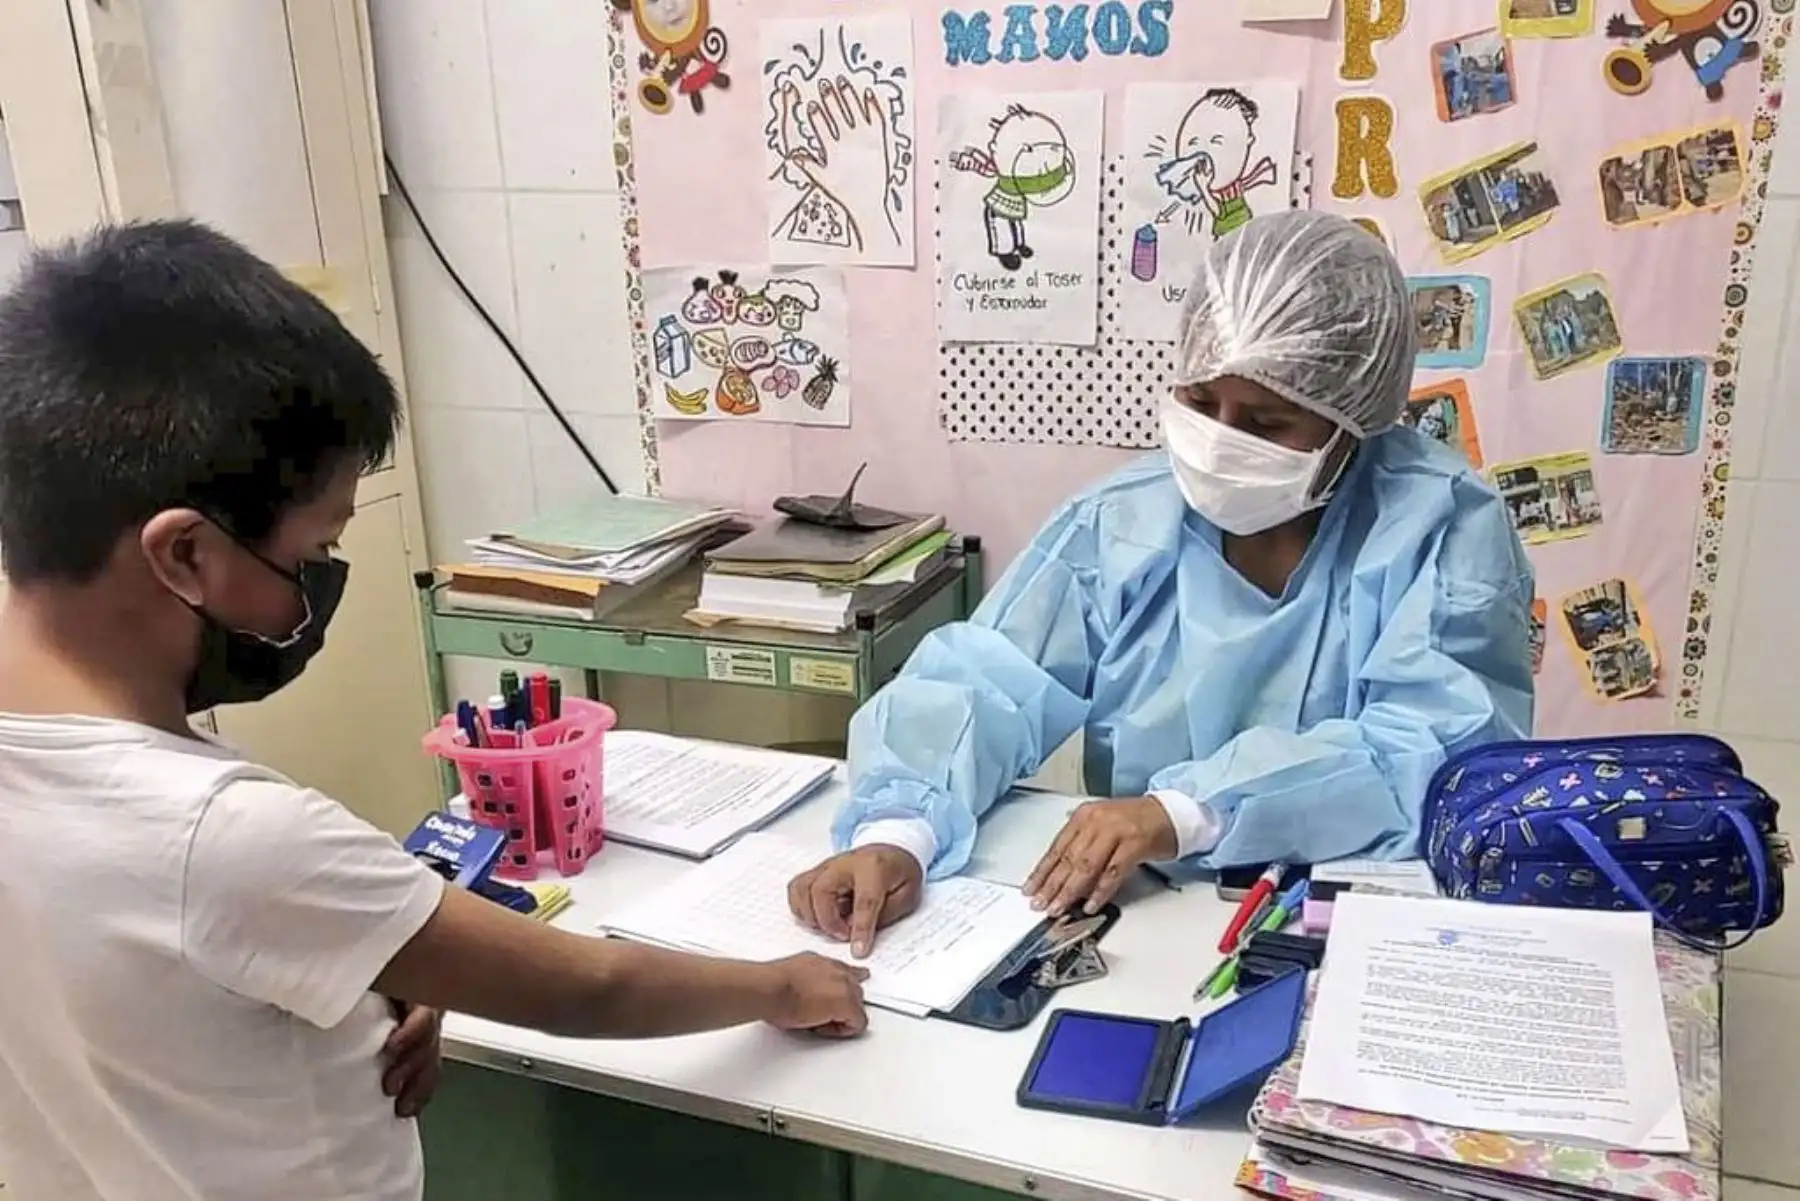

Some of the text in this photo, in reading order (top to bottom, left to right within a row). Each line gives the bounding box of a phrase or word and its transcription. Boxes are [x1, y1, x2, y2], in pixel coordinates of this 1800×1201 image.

[942, 0, 1174, 66] MANOS
[1332, 0, 1408, 244] PR
[953, 271, 1083, 291] Cubrirse al Toser
[965, 297, 974, 312] y
